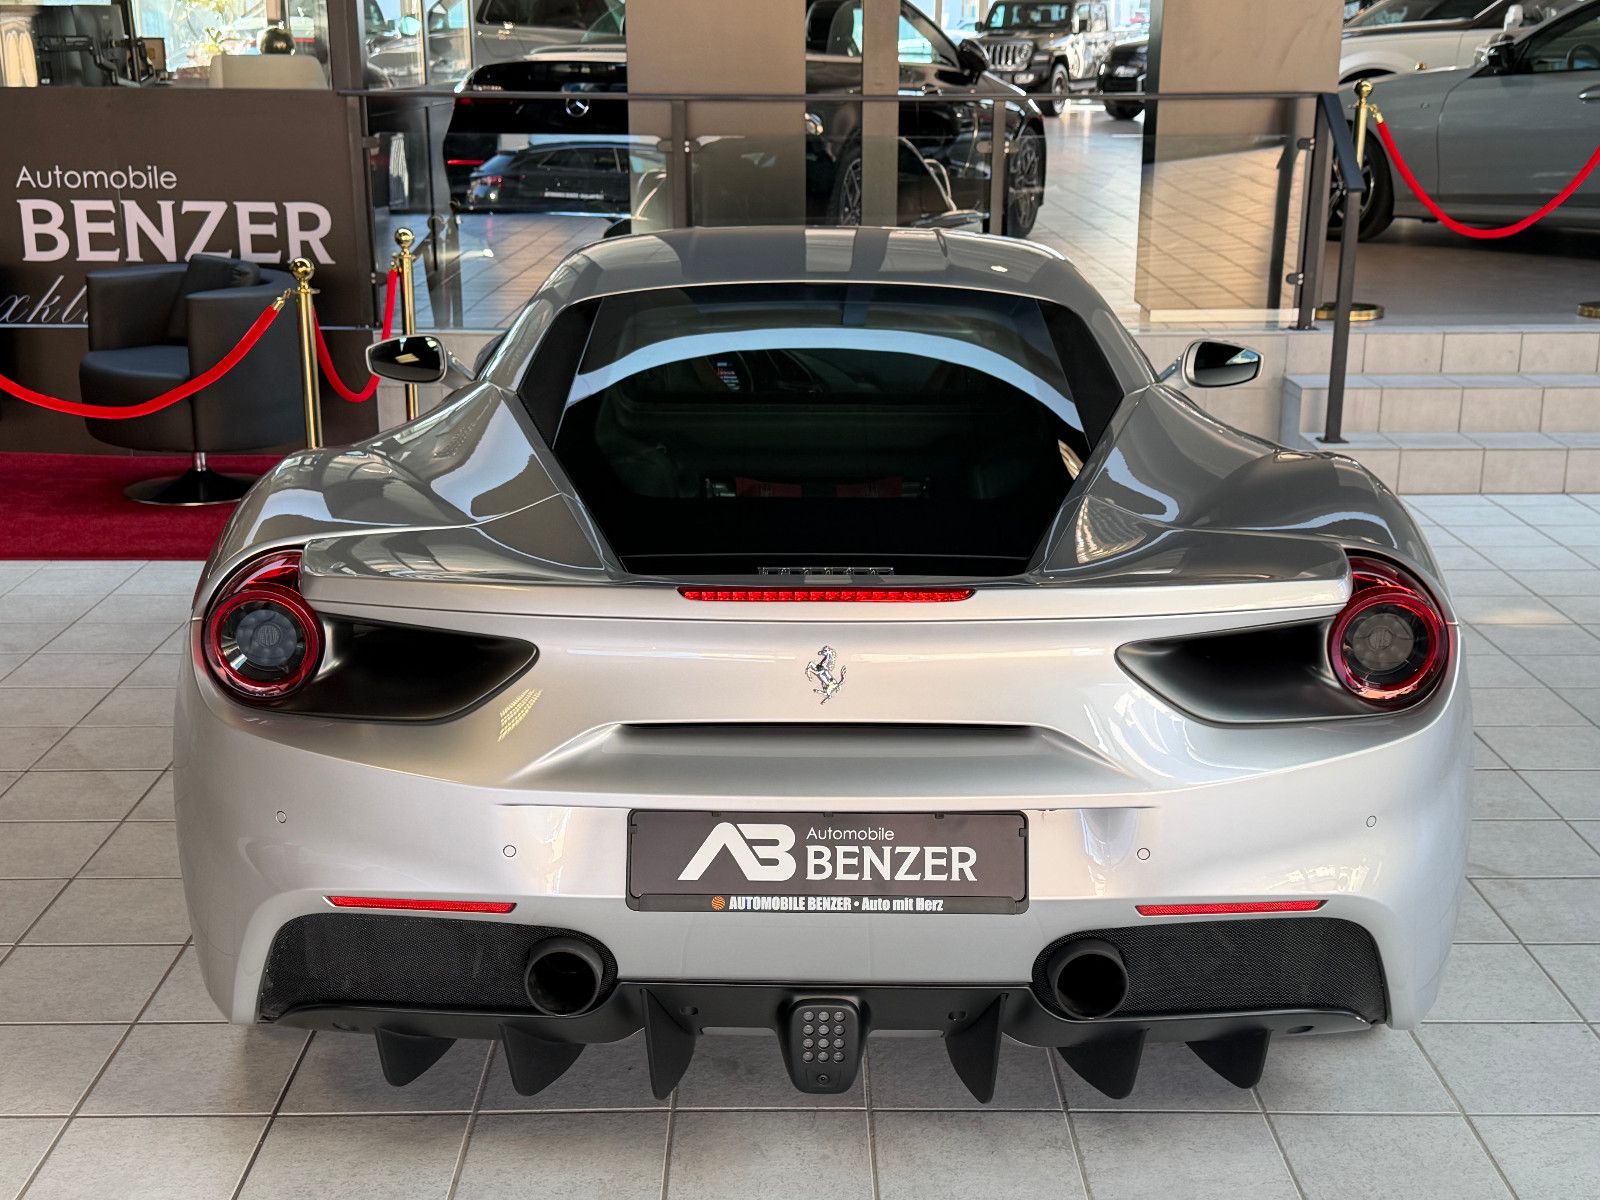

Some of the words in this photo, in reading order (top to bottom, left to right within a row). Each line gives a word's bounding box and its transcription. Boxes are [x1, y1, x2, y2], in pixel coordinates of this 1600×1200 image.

[16, 165, 178, 190] Automobile
[16, 198, 336, 265] BENZER
[805, 826, 895, 841] Automobile
[805, 844, 978, 882] BENZER
[728, 896, 806, 911] AUTOMOBILE
[807, 897, 852, 911] BENZER
[861, 897, 891, 912] Auto
[892, 897, 914, 911] mit
[915, 897, 944, 912] Herz
